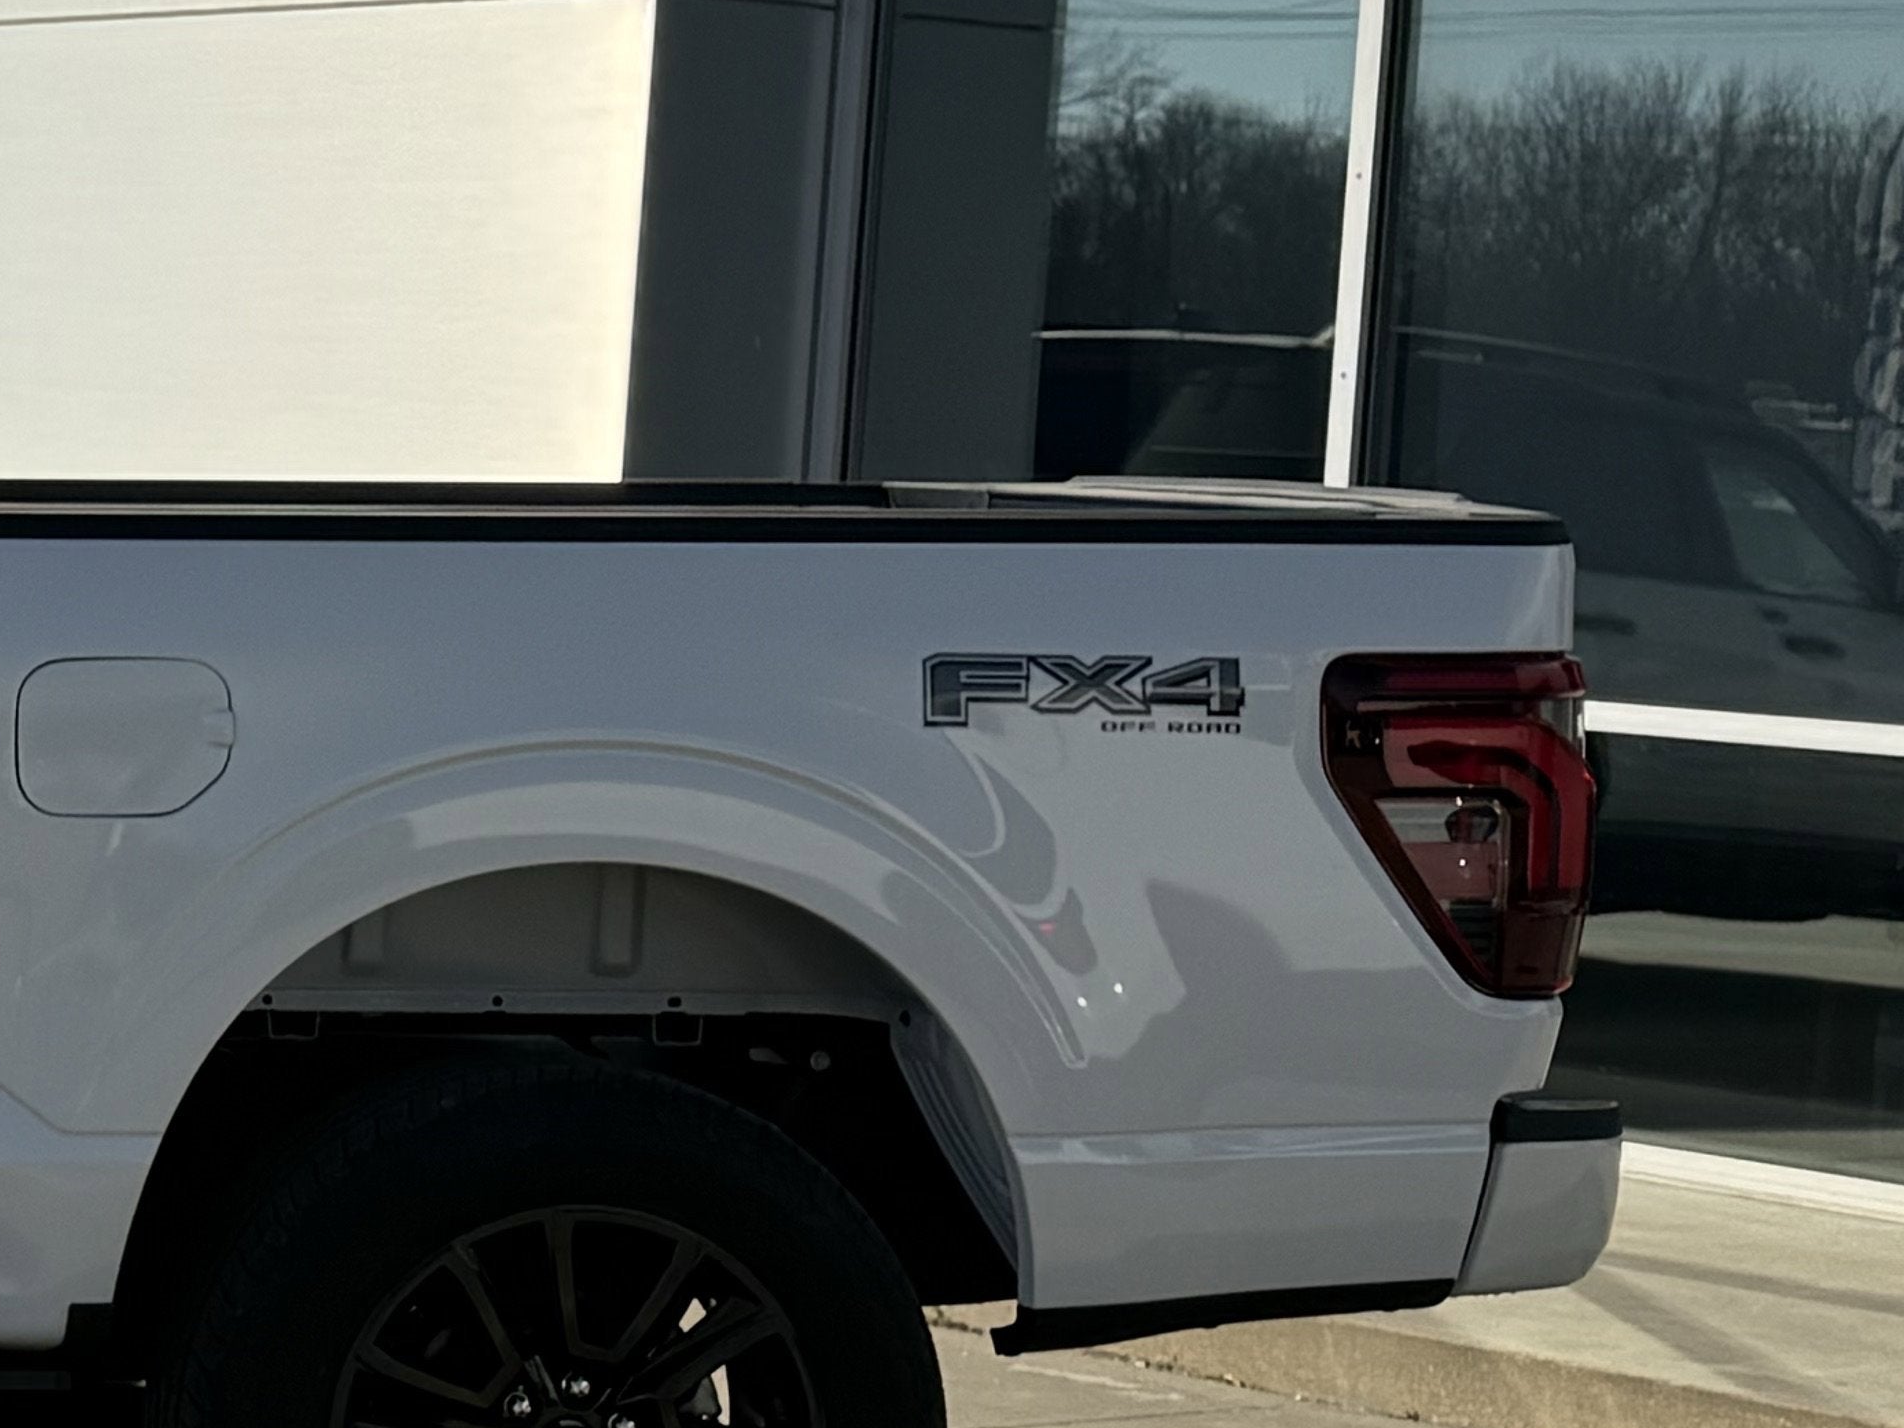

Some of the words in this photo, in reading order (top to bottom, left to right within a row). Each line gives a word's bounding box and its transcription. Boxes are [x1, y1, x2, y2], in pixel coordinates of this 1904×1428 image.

[922, 652, 1245, 727] FX4
[1100, 720, 1156, 732] OFF
[1167, 721, 1241, 734] ROAD
